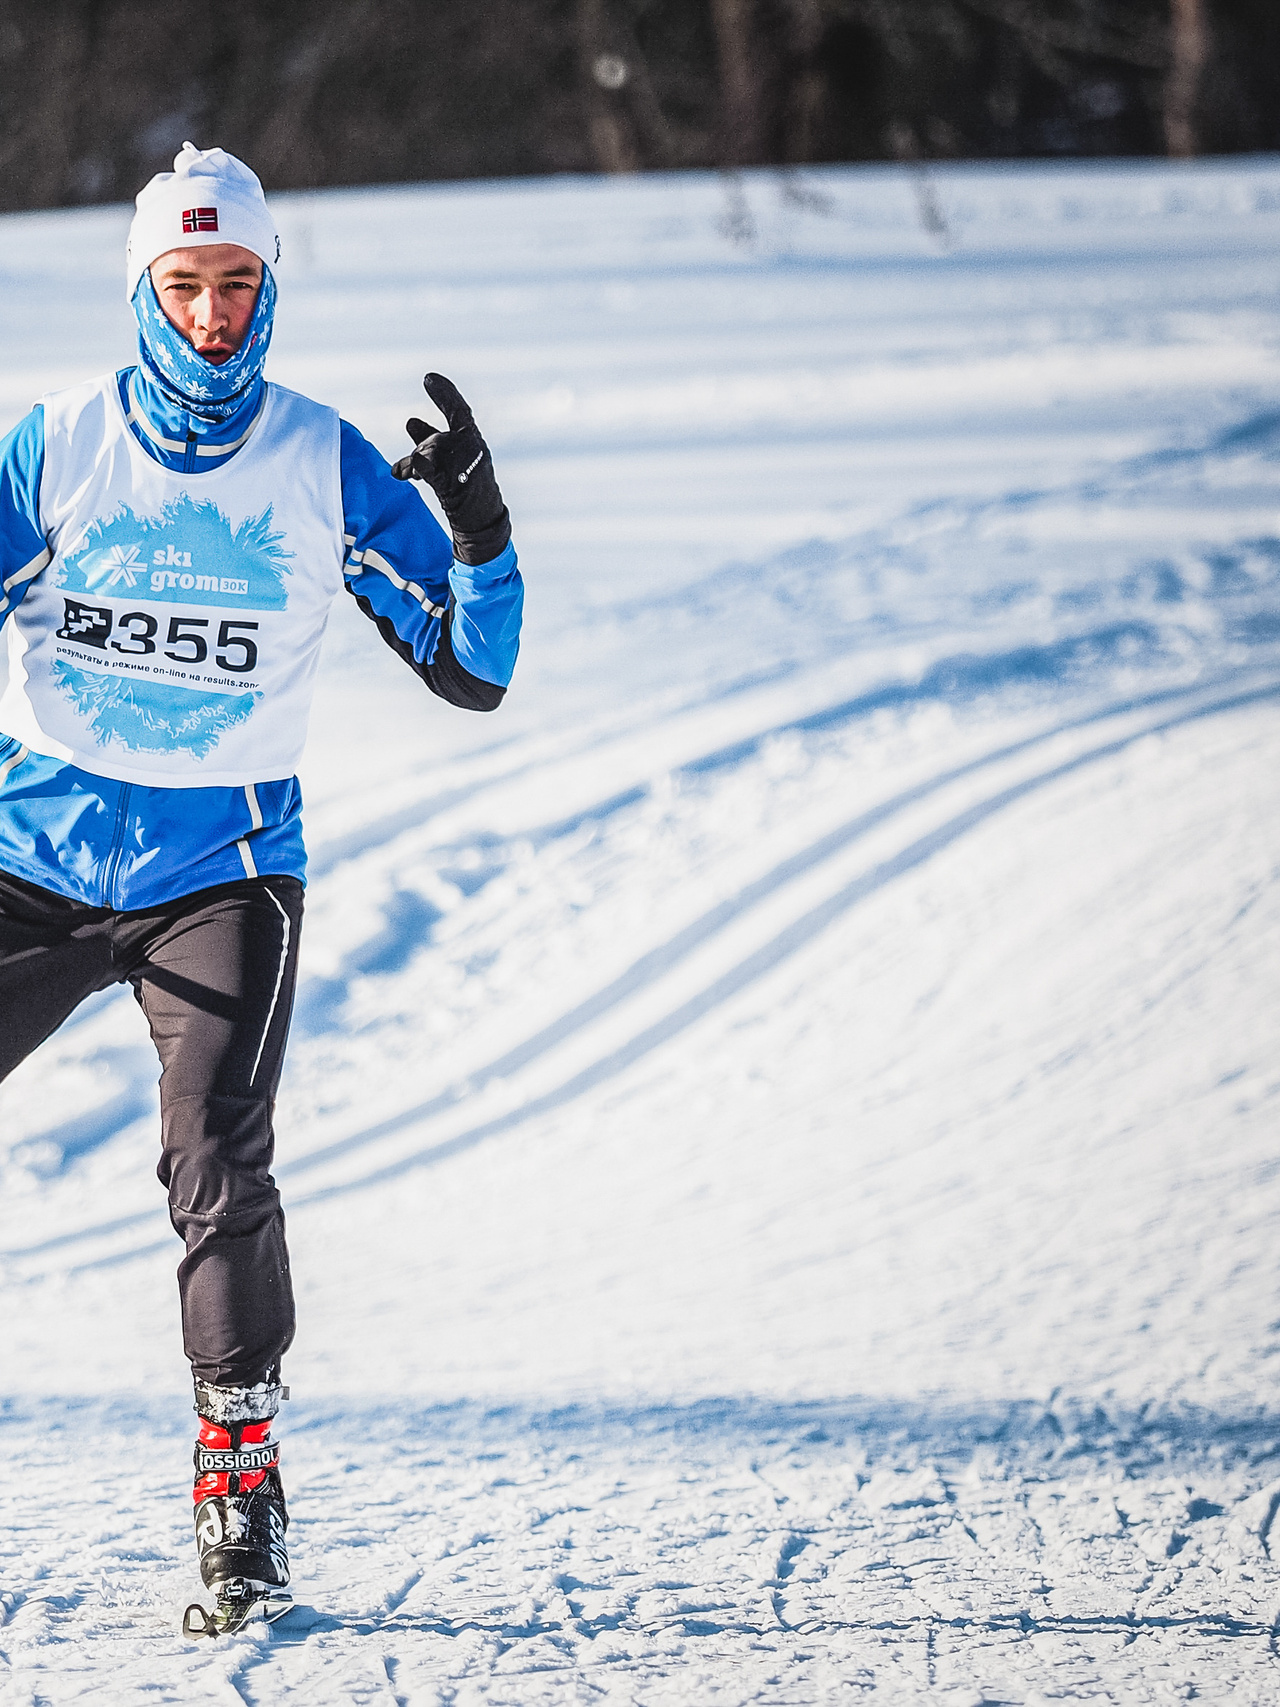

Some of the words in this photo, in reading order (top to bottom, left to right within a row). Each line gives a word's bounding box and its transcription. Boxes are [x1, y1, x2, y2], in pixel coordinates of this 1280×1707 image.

[152, 544, 192, 567] ski
[149, 570, 219, 592] grom
[222, 580, 247, 592] 30K
[111, 611, 260, 673] 355
[56, 646, 102, 665] результаты
[112, 661, 150, 672] режиме
[152, 667, 187, 679] on-line
[189, 673, 201, 682] на
